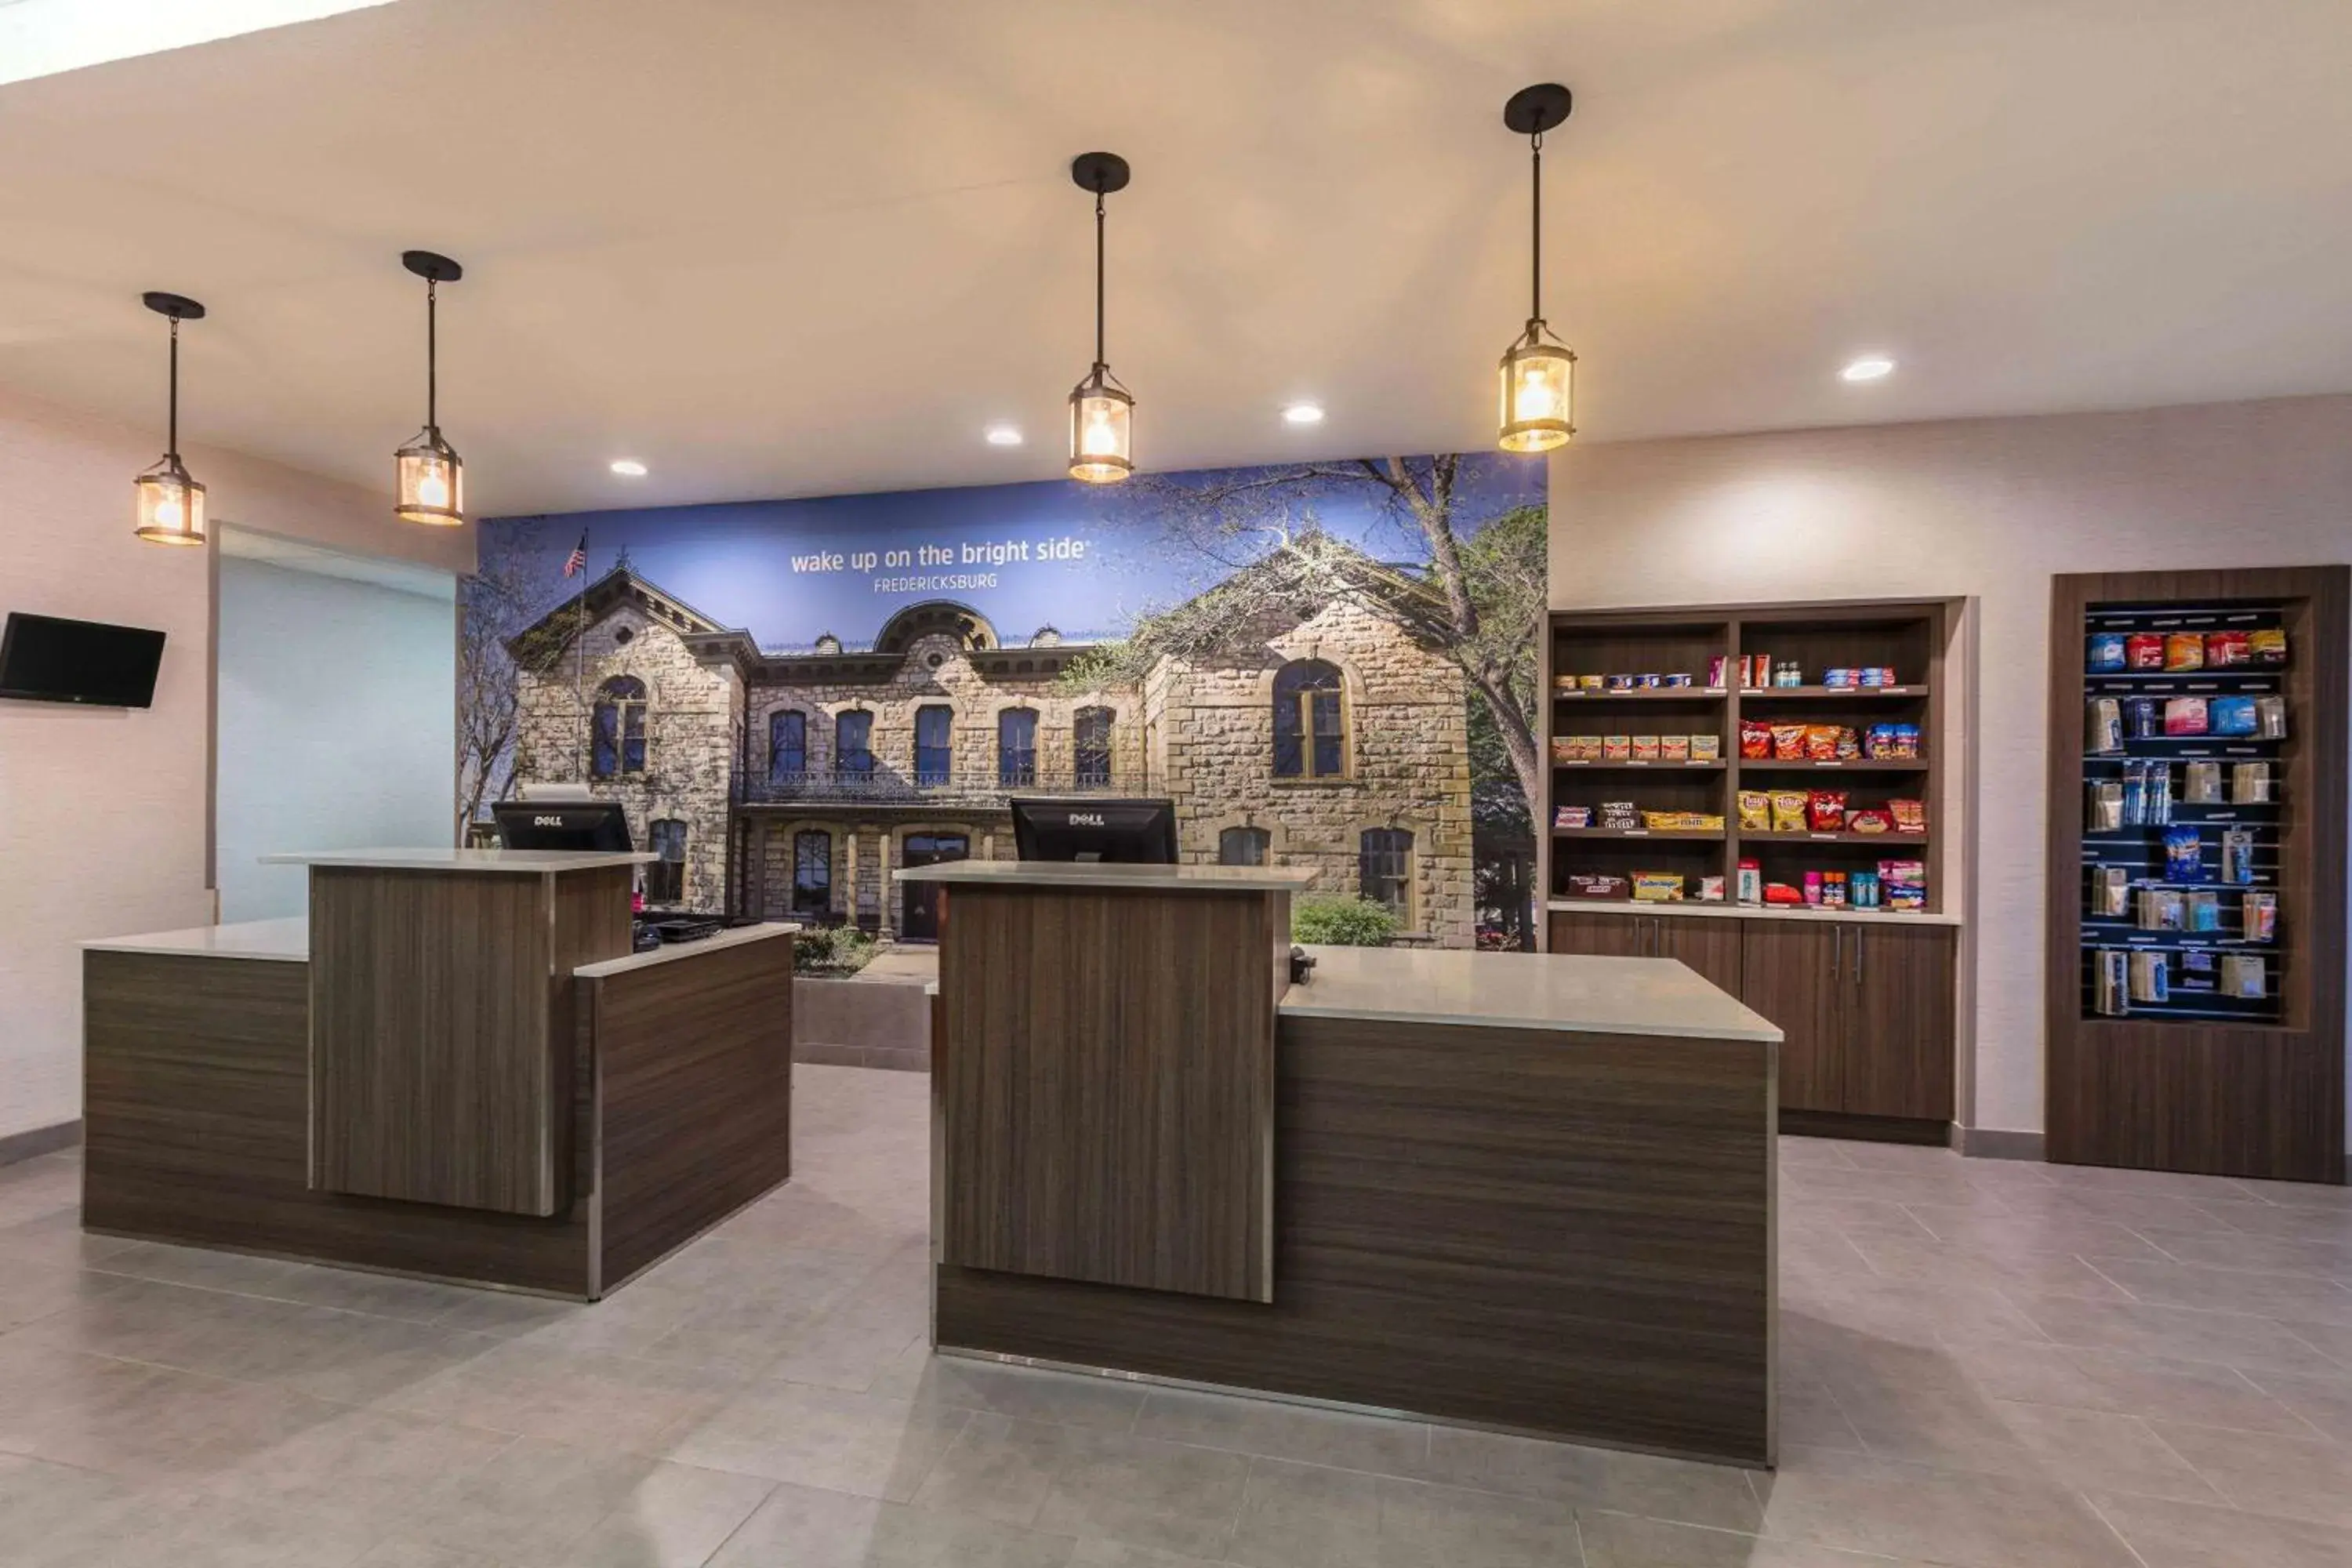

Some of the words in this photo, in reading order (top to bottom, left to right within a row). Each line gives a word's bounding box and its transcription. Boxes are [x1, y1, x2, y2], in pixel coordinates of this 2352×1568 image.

[791, 551, 844, 573] wake
[851, 551, 877, 573] up
[885, 550, 910, 568] on
[919, 545, 953, 565] the
[962, 540, 1029, 565] bright
[1036, 536, 1083, 561] side
[874, 573, 996, 593] FREDERICKSBURG
[534, 816, 563, 827] DELL
[1069, 814, 1105, 826] DELL
